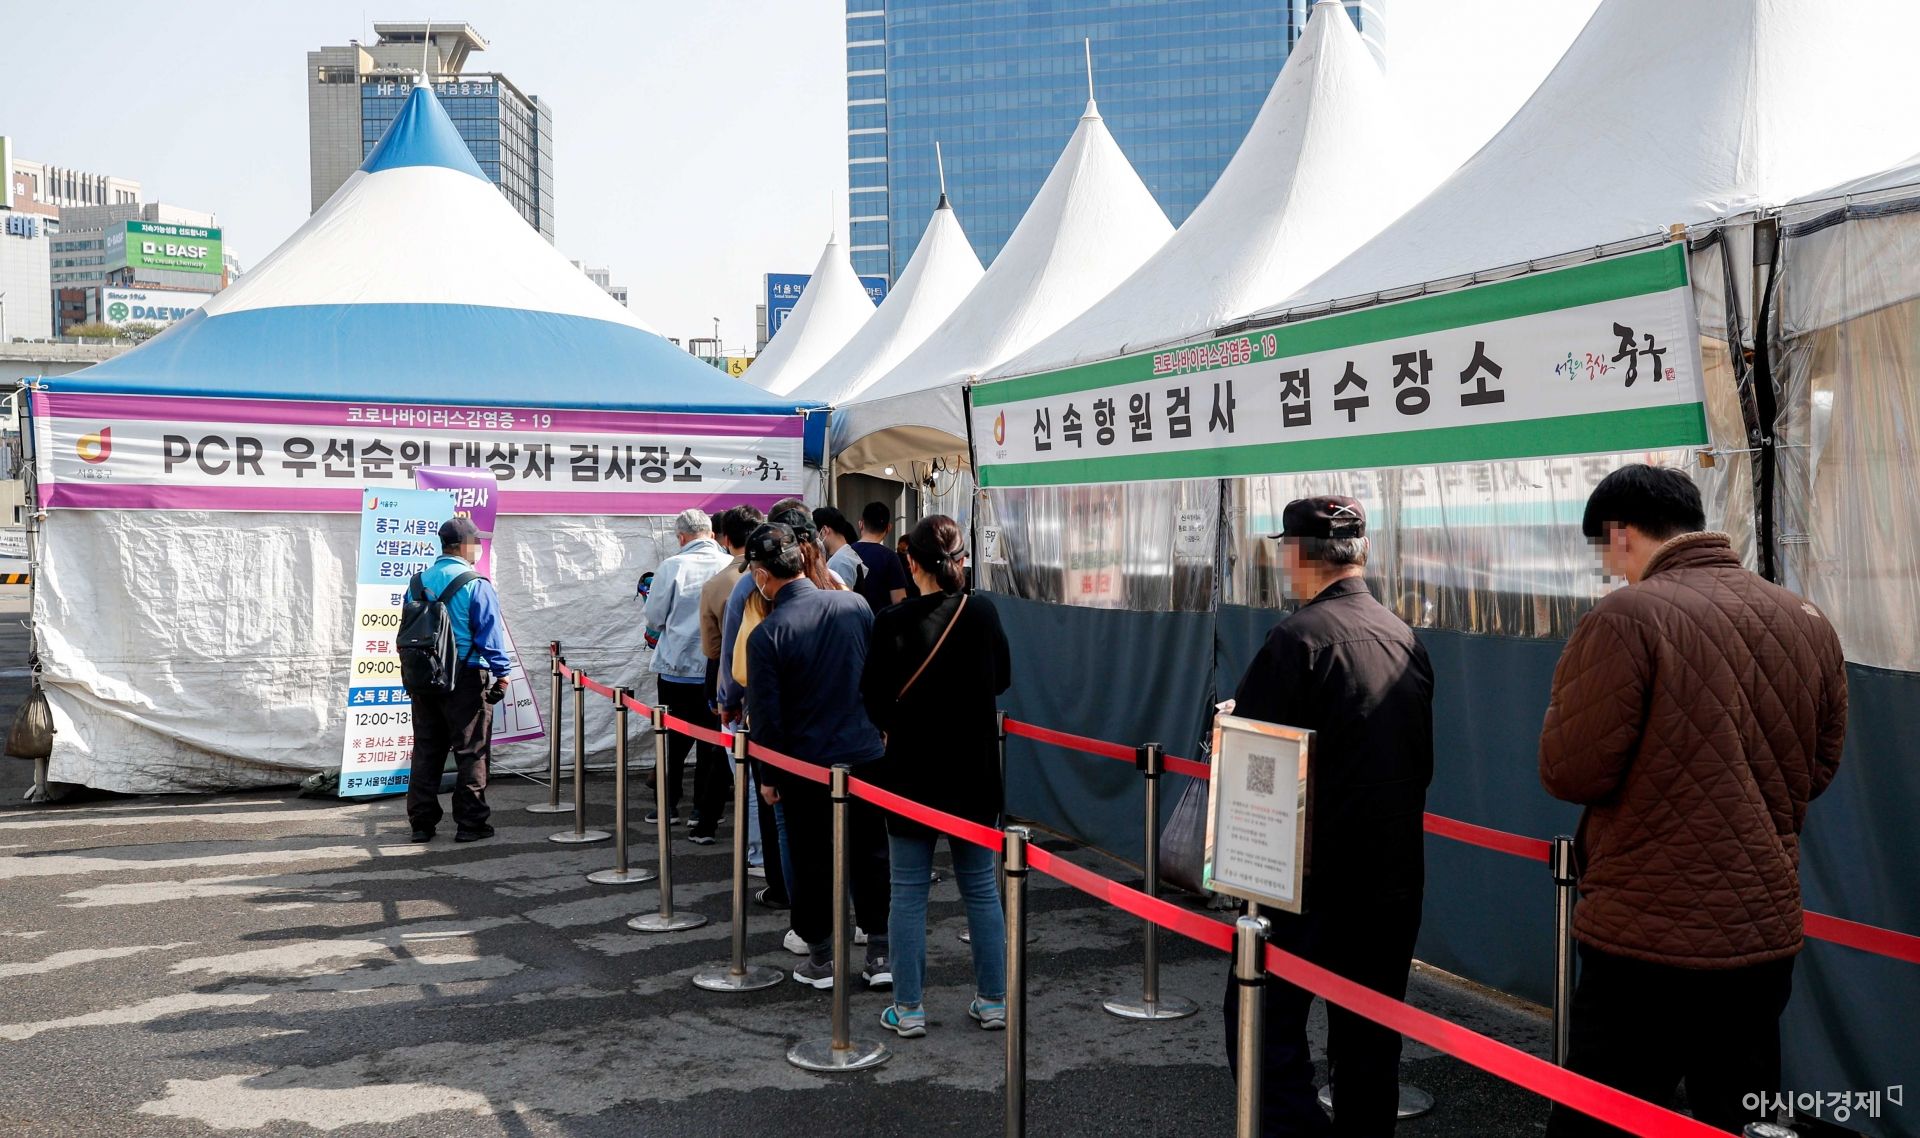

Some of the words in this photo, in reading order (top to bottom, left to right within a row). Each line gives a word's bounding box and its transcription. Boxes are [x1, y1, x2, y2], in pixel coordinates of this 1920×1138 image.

[378, 84, 395, 96] HF
[401, 84, 493, 96] 한택금융공사
[166, 243, 208, 259] BASF
[773, 283, 801, 294] 서울역
[1153, 338, 1251, 375] 코로나바이러스감염증
[1260, 334, 1277, 358] 19
[1555, 352, 1583, 380] 서울의
[1586, 352, 1616, 380] 중심
[1611, 322, 1667, 387] 중구
[1033, 380, 1236, 452] 신속항원검사
[1279, 341, 1505, 428] 접수장소
[346, 407, 515, 429] 코로나바이러스감염증
[532, 414, 552, 429] 19
[163, 434, 265, 476] PCR
[282, 437, 431, 479] 우선순위
[449, 442, 554, 482] 대상자
[569, 444, 703, 483] 검사장소
[76, 468, 113, 480] 서울중구
[755, 455, 784, 481] 중구
[375, 517, 400, 534] 중구
[403, 519, 439, 536] 서울역
[375, 539, 435, 557] 선별검사소
[353, 690, 375, 703] 소독
[378, 690, 388, 703] 및
[365, 737, 394, 749] 검사소
[357, 751, 397, 764] 조기마감
[347, 778, 362, 788] 중구
